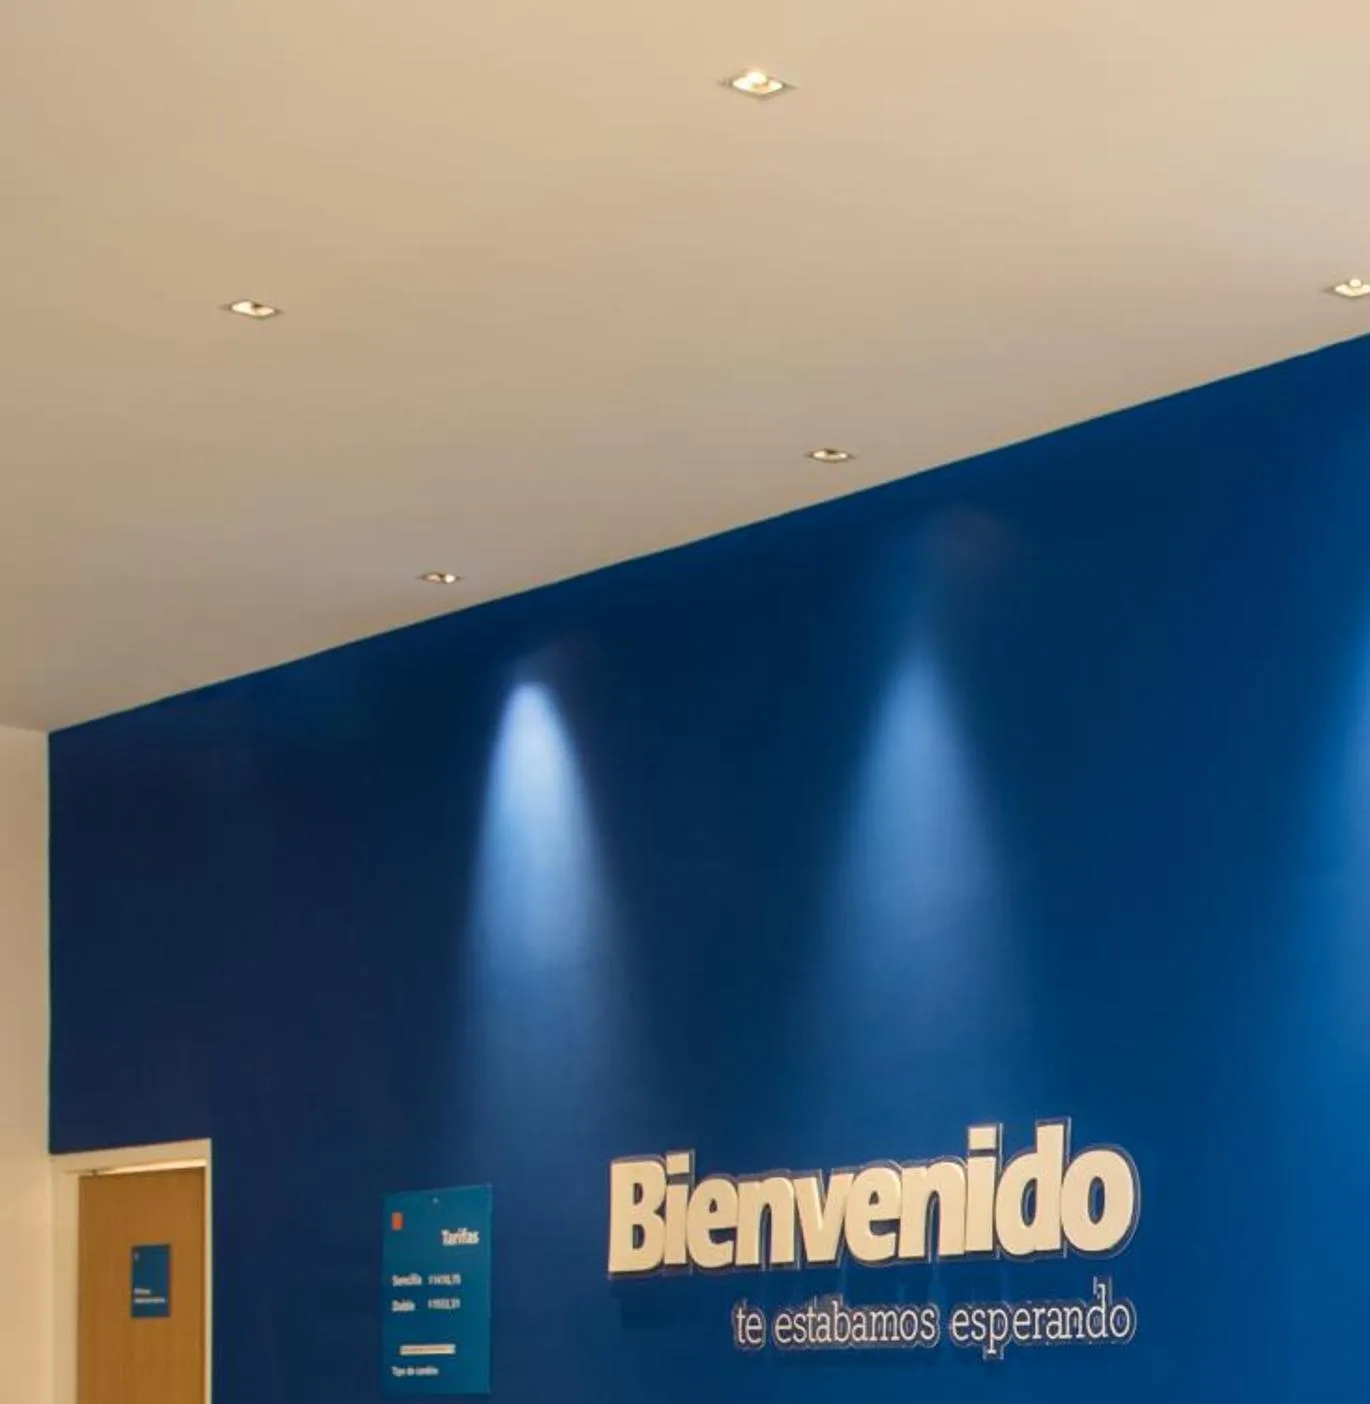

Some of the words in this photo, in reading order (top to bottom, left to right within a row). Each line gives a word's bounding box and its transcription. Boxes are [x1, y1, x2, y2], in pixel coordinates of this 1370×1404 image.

[608, 1122, 1137, 1274] Bienvenido
[736, 1306, 763, 1344] te
[774, 1299, 936, 1344] estabamos
[951, 1282, 1131, 1354] esperando
